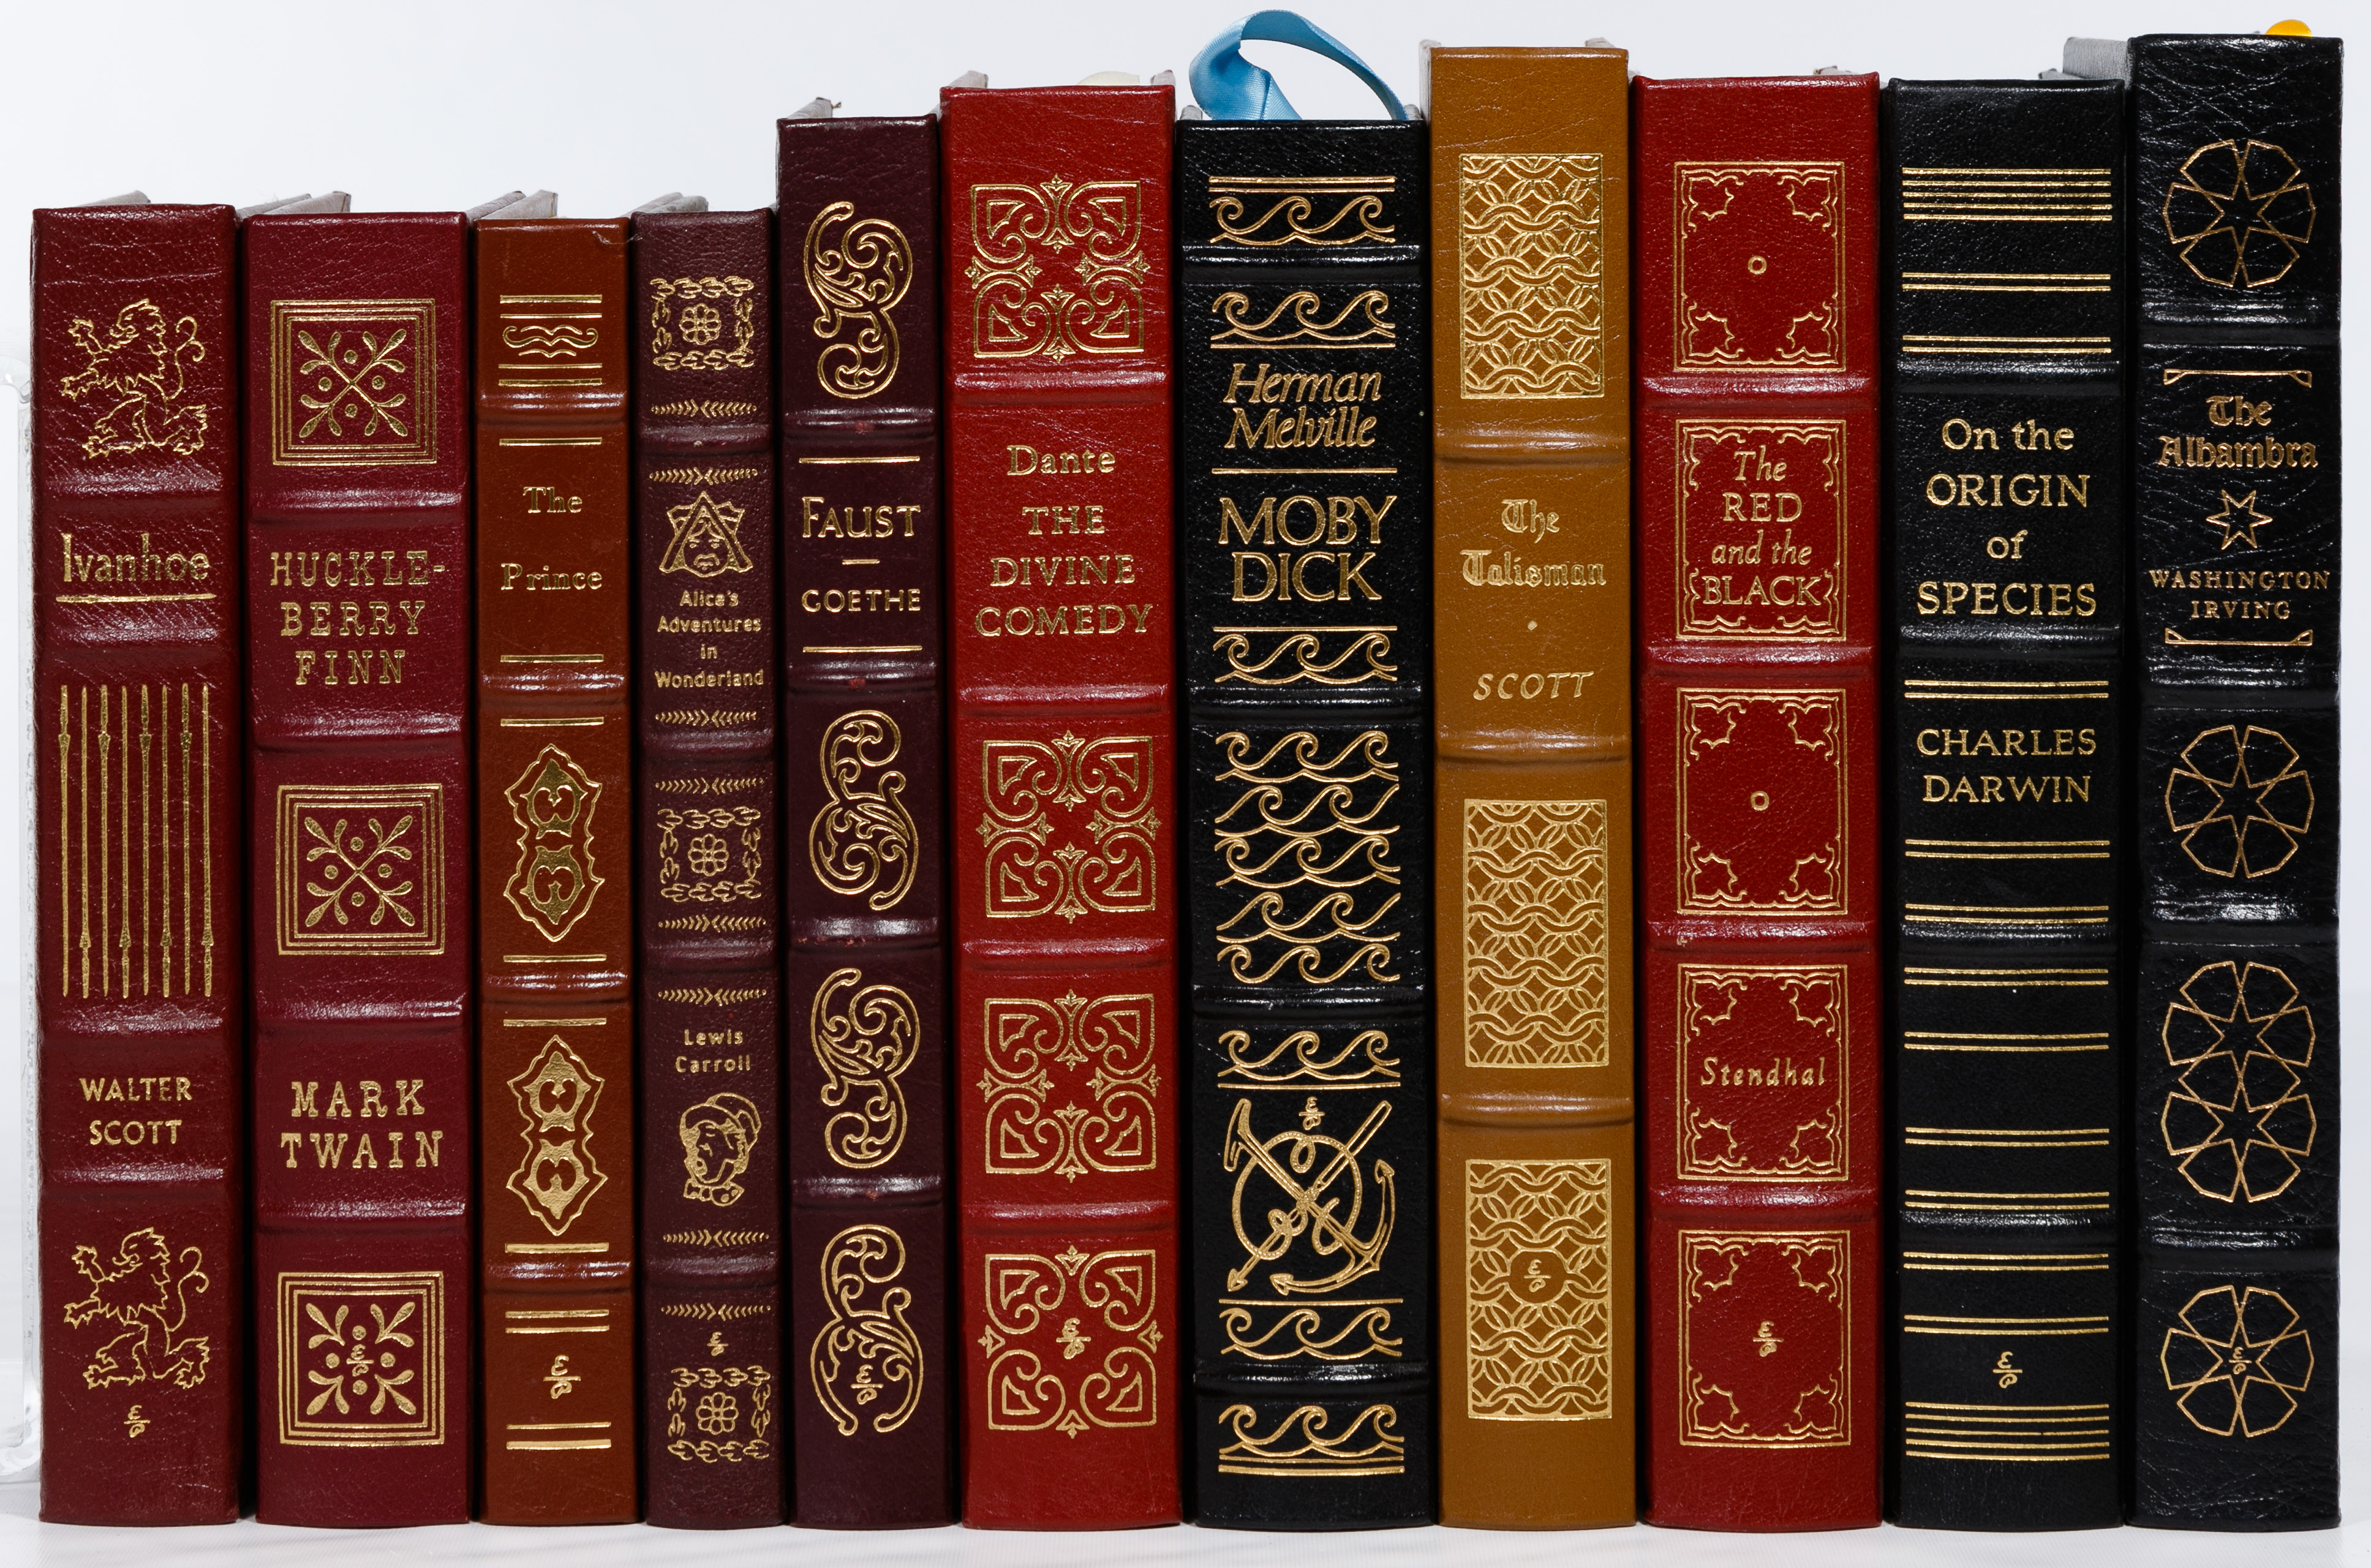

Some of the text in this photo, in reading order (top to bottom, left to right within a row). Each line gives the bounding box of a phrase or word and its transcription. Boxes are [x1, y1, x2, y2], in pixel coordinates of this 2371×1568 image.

[1224, 363, 1382, 404] Herman
[2206, 396, 2272, 426] The
[1224, 407, 1377, 449] Melville
[1942, 418, 2075, 451] On the
[1007, 445, 1116, 475] Dante
[1733, 445, 1787, 481] The
[2158, 435, 2318, 468] Alhambra
[523, 486, 582, 514] The
[1926, 474, 2090, 507] ORIGIN
[1022, 505, 1106, 535] THE
[1219, 496, 1397, 546] MOBY
[1501, 499, 1560, 544] The
[1723, 492, 1803, 522] RED
[62, 533, 210, 583] Ivanhoe
[1711, 529, 1812, 565] and the
[1986, 529, 2027, 559] of
[270, 550, 446, 586] HUCKLE-
[501, 563, 603, 590] Prince
[990, 555, 1136, 587] DIVINE
[1232, 552, 1382, 601] DICK
[1460, 549, 1607, 587] Talisman
[2149, 569, 2330, 589] WASHINGTON
[680, 590, 739, 607] Alice's
[801, 589, 921, 612] GOETHE
[1702, 575, 1822, 606] BLACK
[1917, 581, 2097, 616] SPECIES
[281, 601, 426, 636] BERRY
[657, 615, 761, 633] Adventures
[974, 604, 1153, 636] COMEDY
[2191, 601, 2291, 620] IRVING
[701, 644, 717, 659] in
[295, 650, 405, 685] FINN
[655, 669, 764, 688] Wonderland
[1472, 671, 1594, 701] SCOTT
[1917, 728, 2097, 756] CHARLES
[1923, 775, 2090, 803] DARWIN
[684, 1029, 744, 1046] Lewis
[676, 1055, 752, 1073] Carroll
[1701, 1057, 1826, 1087] Stendhal
[80, 1077, 194, 1102] WALTER
[291, 1080, 426, 1118] MARK
[89, 1120, 182, 1145] SCOTT
[281, 1131, 444, 1169] TWAIN
